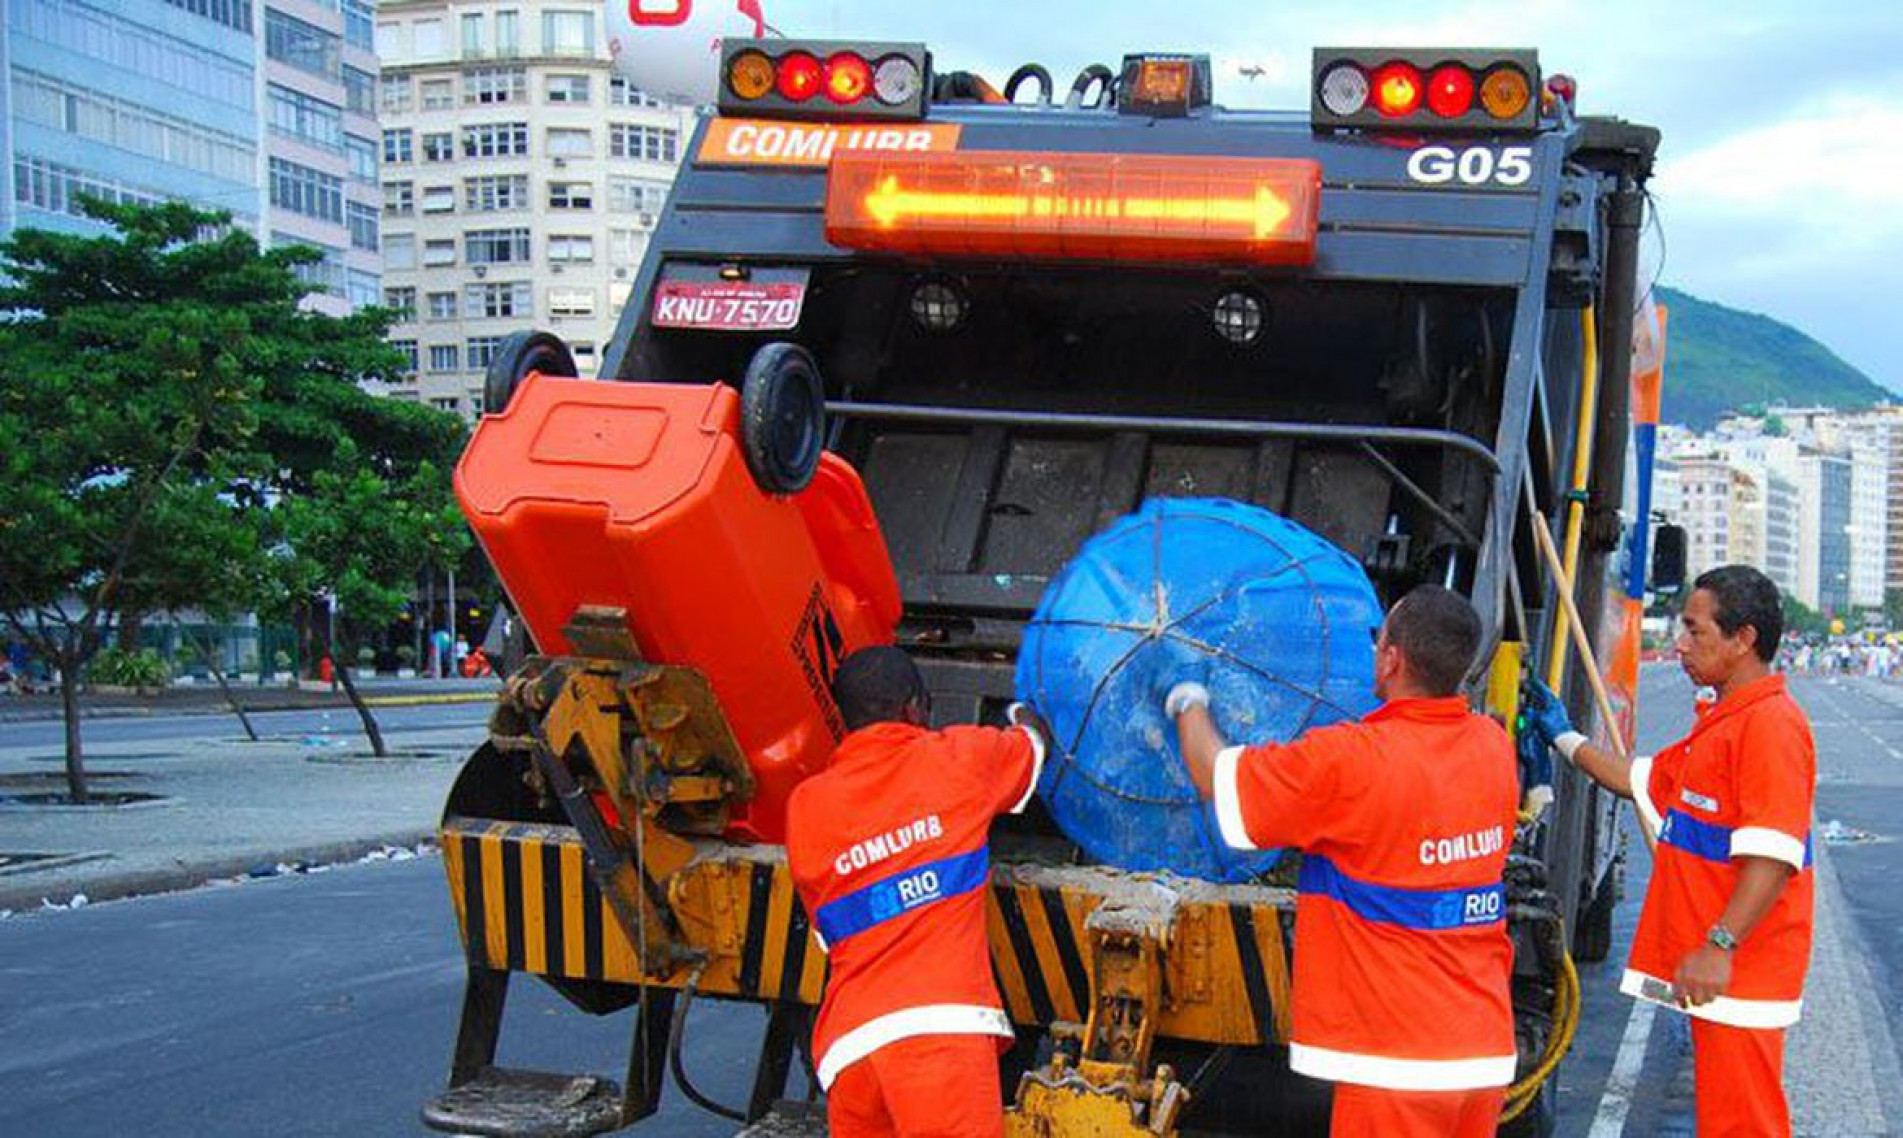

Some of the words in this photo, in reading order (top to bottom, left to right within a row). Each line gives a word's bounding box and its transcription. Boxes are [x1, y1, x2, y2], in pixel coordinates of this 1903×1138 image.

[1406, 147, 1533, 184] G05
[835, 815, 943, 874] COMLURB
[898, 871, 939, 901] RIO
[1466, 891, 1500, 915] RIO
